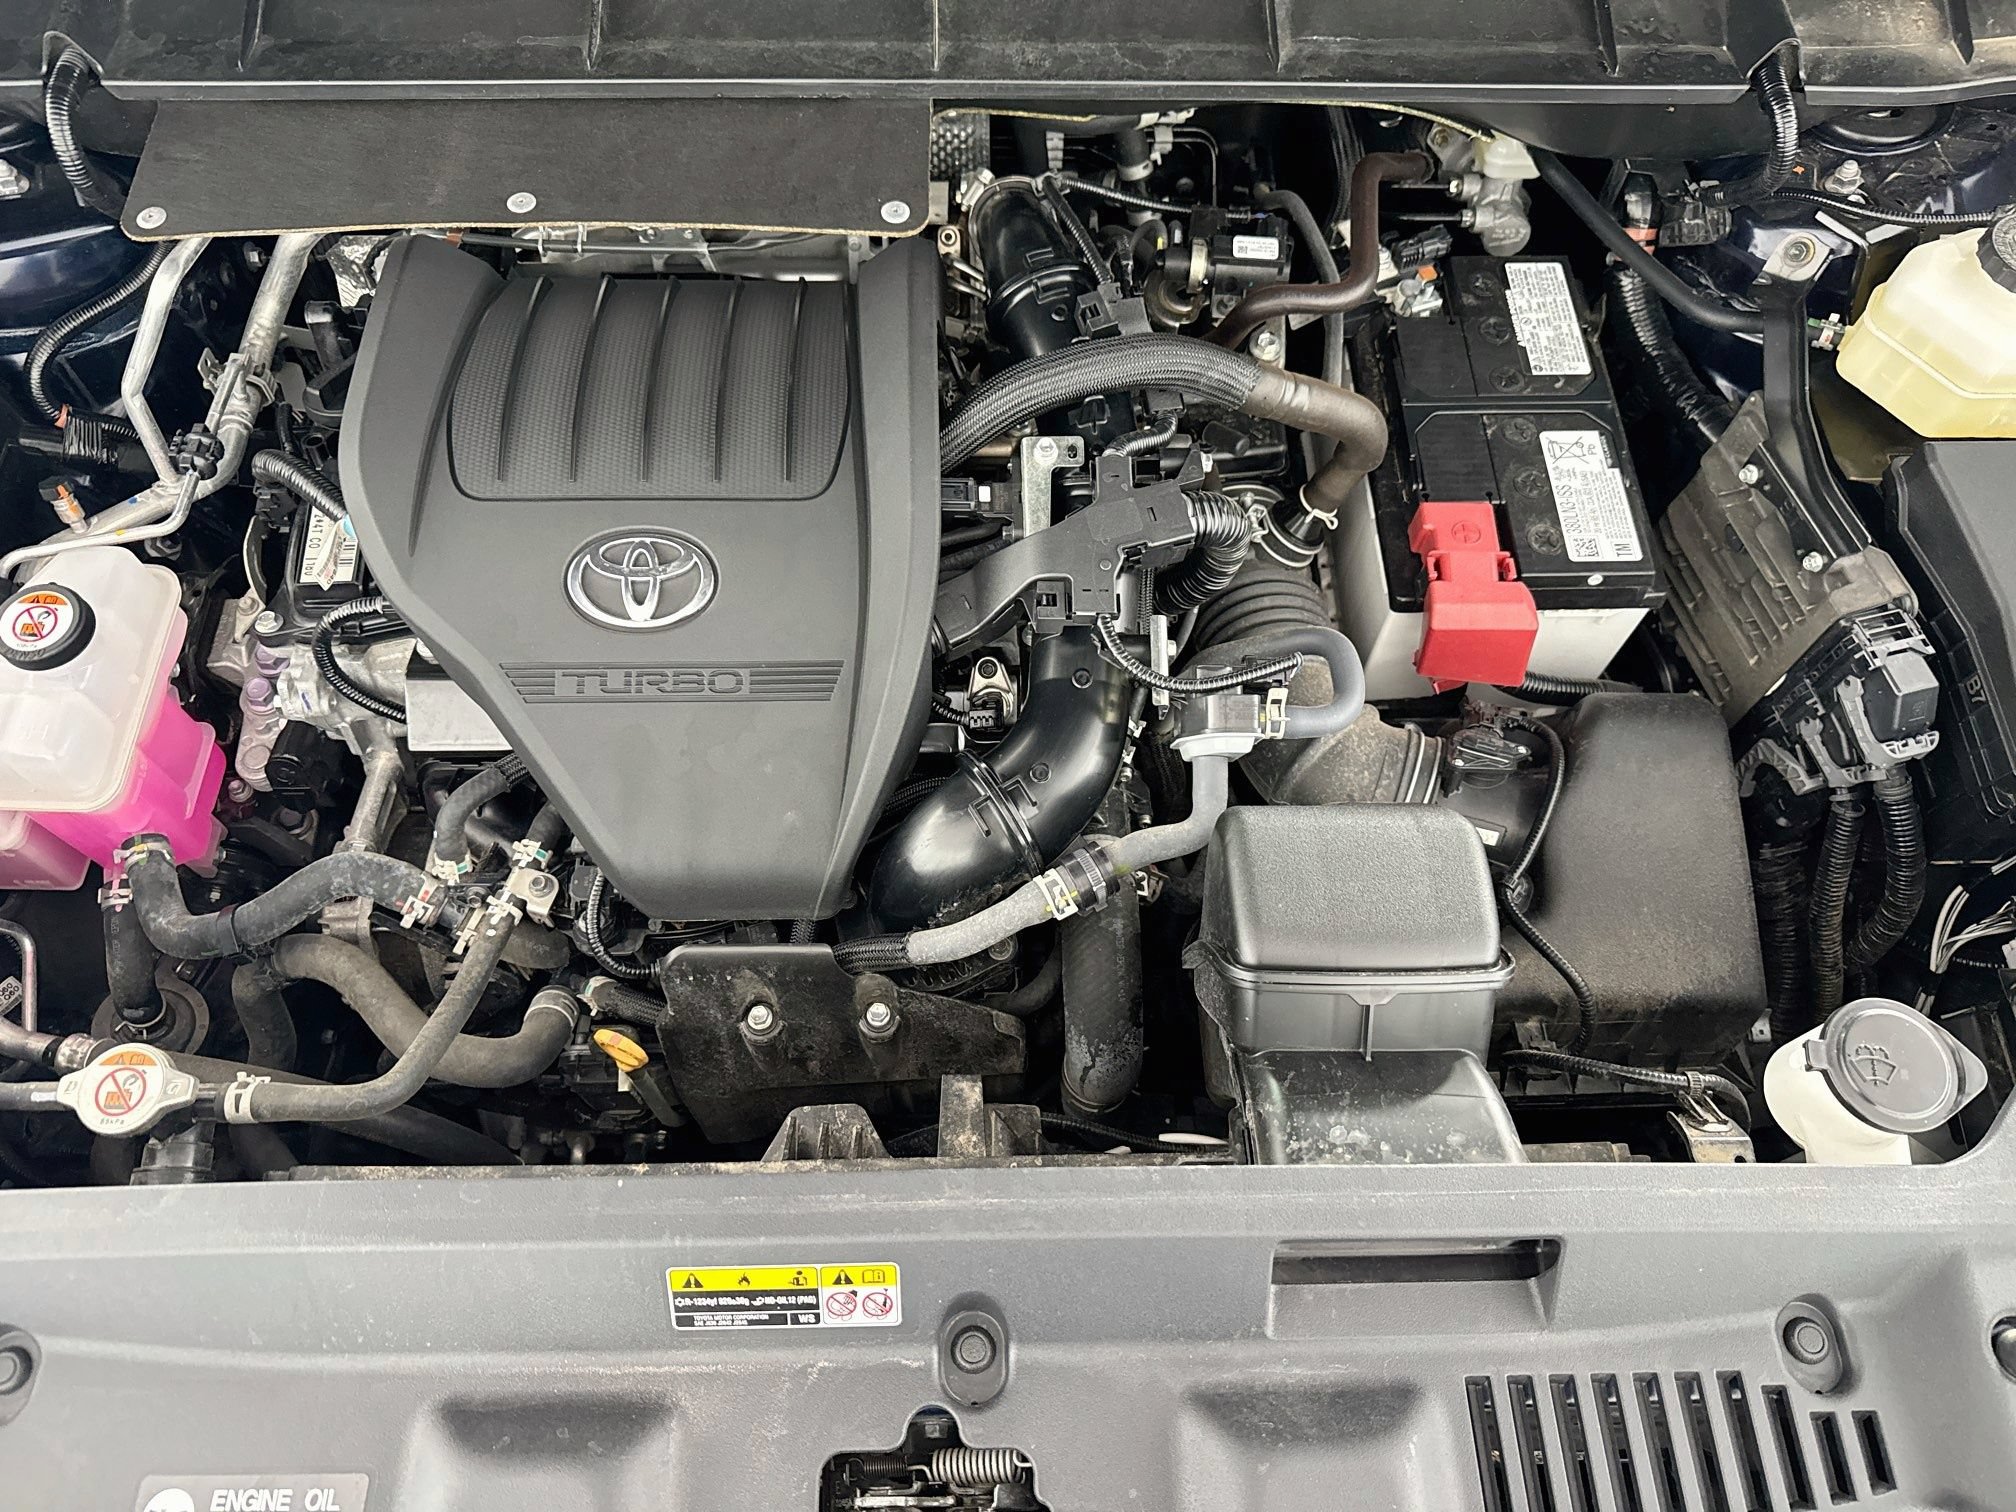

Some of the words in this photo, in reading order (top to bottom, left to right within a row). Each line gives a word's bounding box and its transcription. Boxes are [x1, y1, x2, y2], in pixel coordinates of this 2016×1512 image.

[1587, 444, 1597, 455] Pb
[1614, 543, 1633, 557] TM
[561, 669, 745, 694] TURBO
[1966, 674, 1987, 703] B7
[798, 1313, 816, 1323] WS
[210, 1488, 293, 1512] ENGINE
[304, 1488, 340, 1512] OIL
